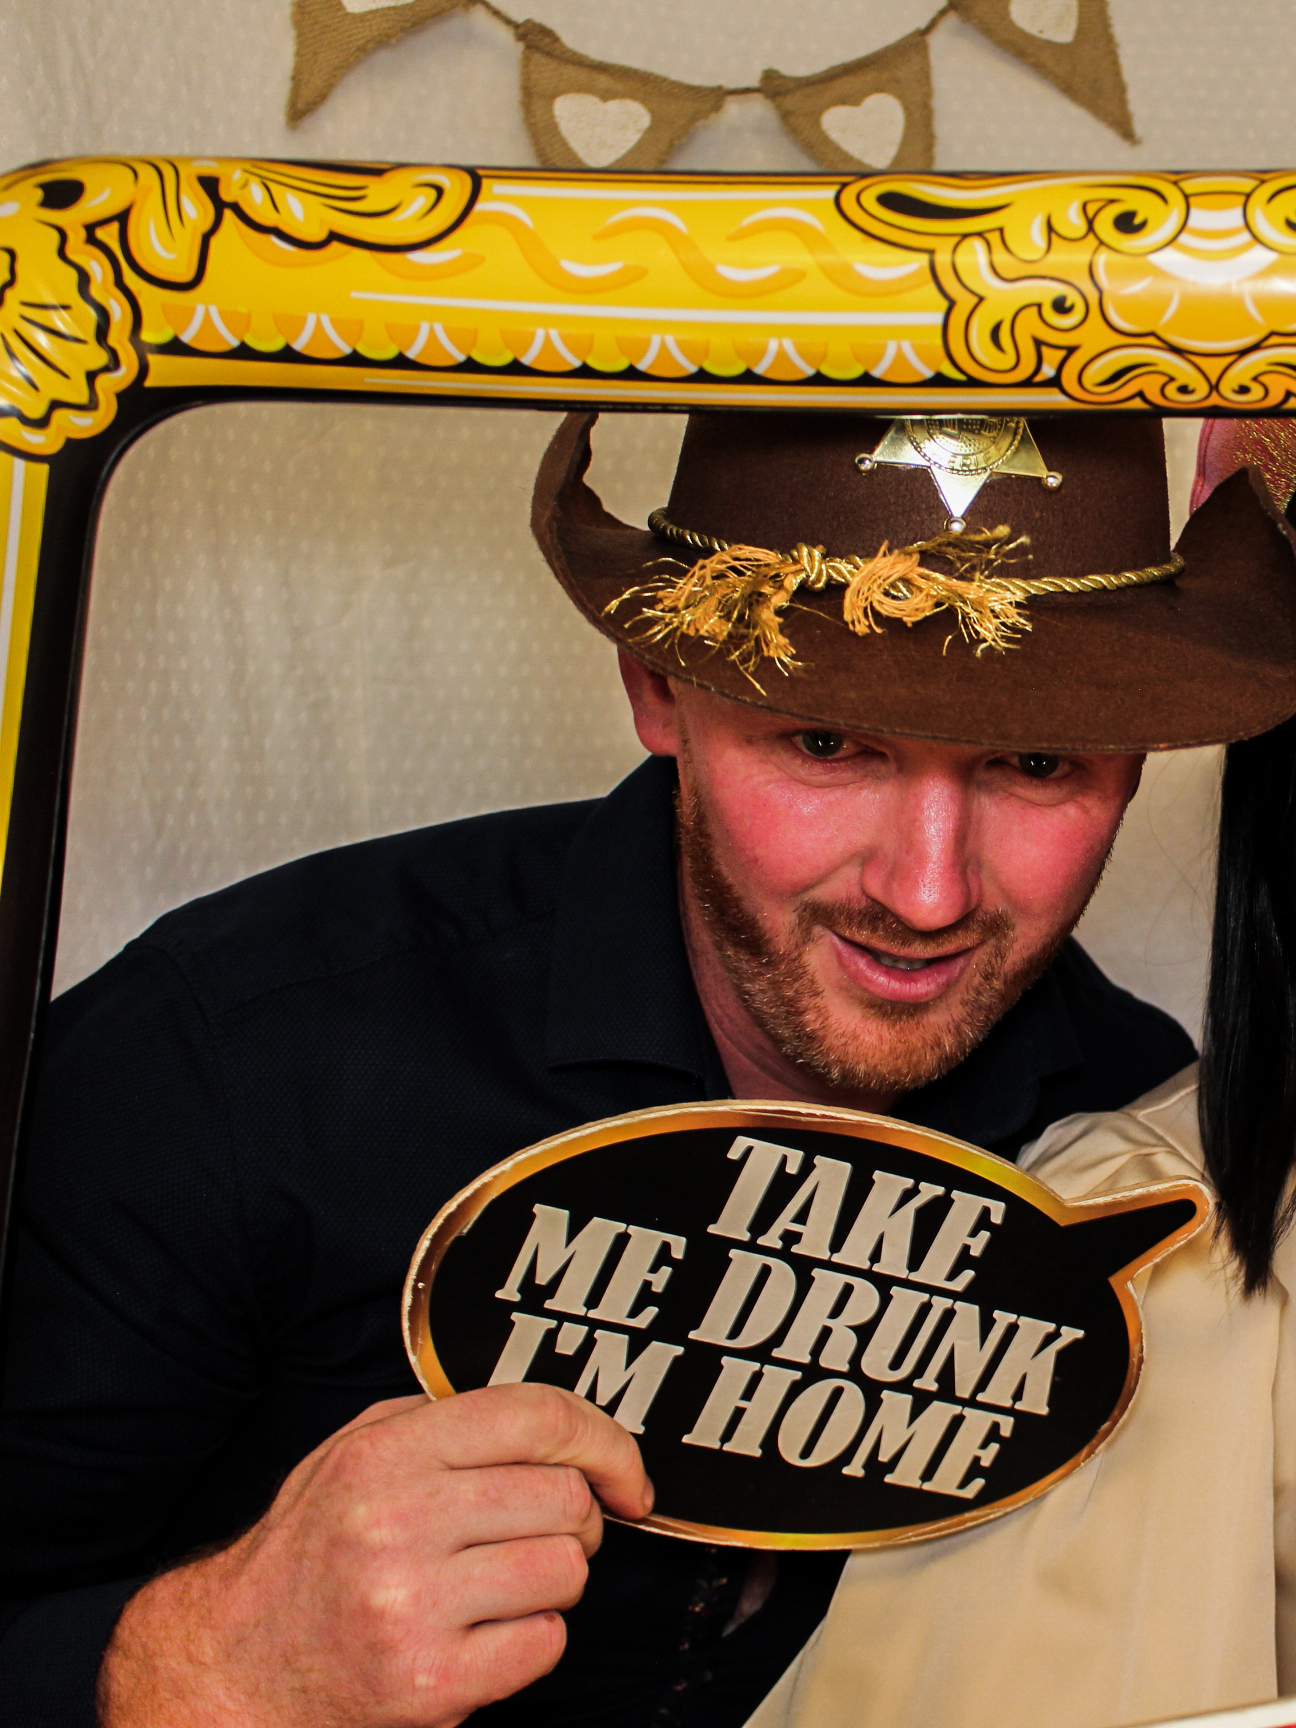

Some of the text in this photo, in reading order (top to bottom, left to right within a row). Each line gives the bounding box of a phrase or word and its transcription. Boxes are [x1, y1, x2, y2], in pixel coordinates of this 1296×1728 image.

[707, 1136, 1005, 1291] TAKE
[495, 1204, 1084, 1415] ME DRUNK
[487, 1312, 1014, 1498] I'M HOME
